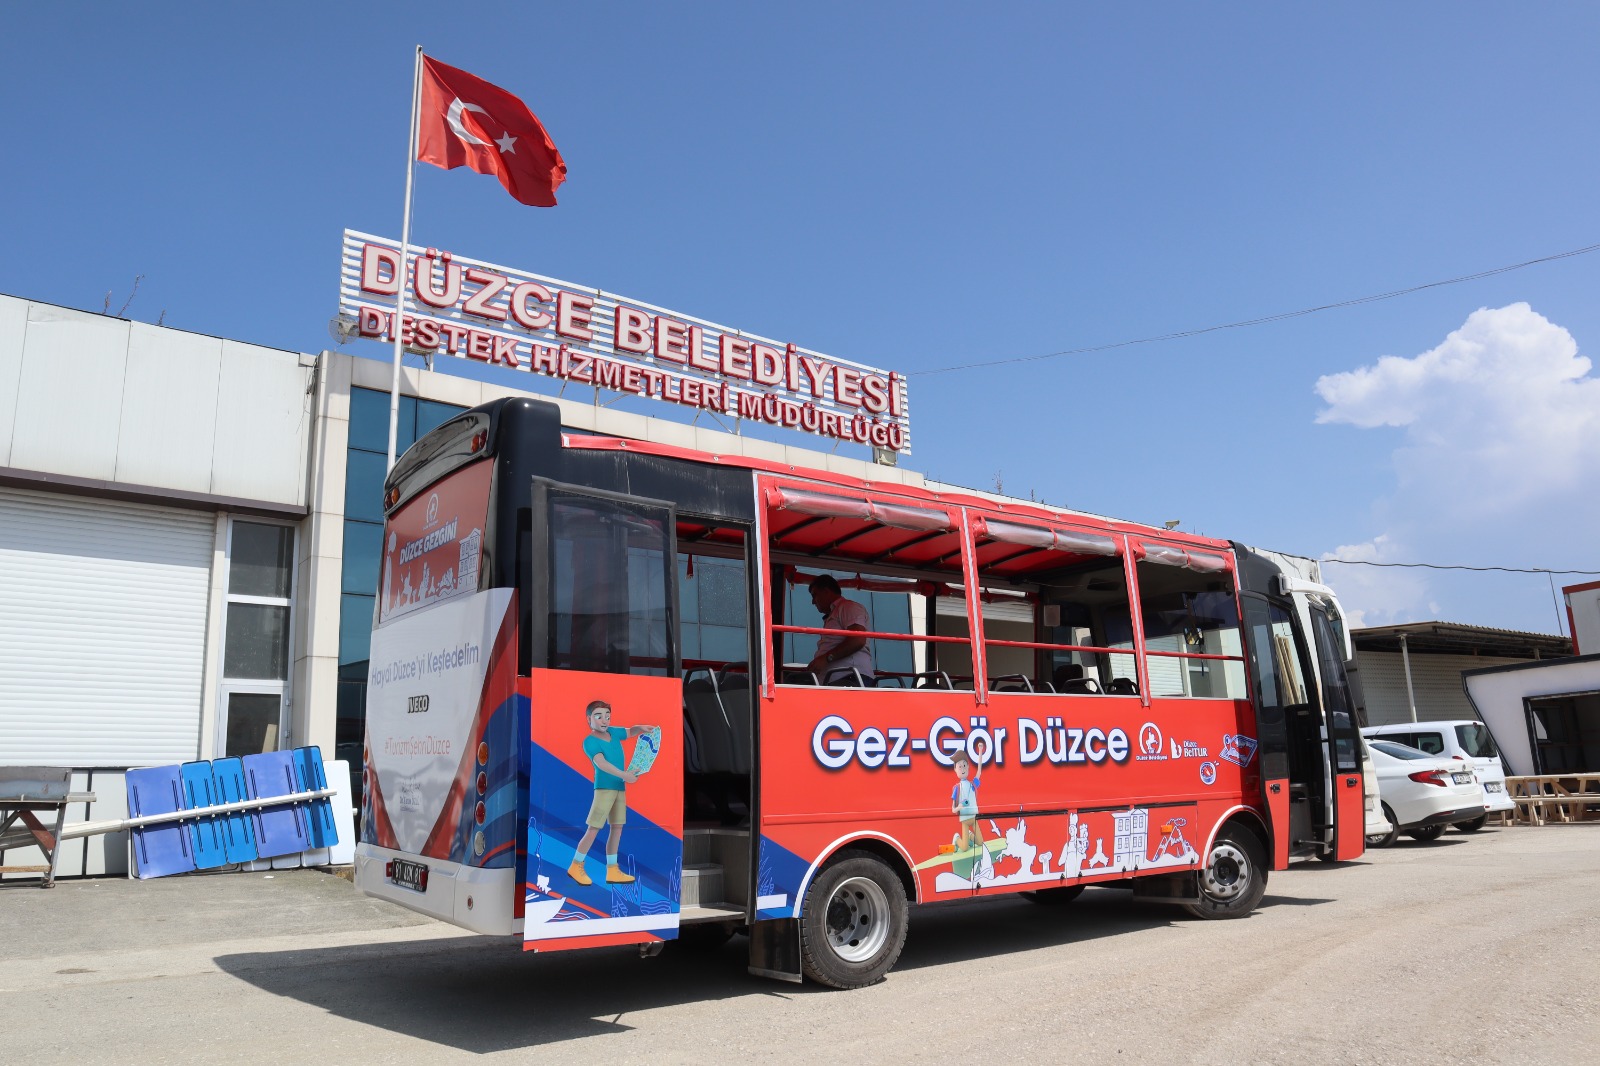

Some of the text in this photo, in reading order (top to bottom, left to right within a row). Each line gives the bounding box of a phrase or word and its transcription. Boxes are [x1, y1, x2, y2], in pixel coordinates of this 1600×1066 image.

[361, 243, 902, 417] DÜZCE BELEDİYESİ
[358, 306, 904, 450] DESTEK HİZMETLERİ MÜDÜRLÜĞÜ
[399, 516, 459, 565] DÜZCE GEZGİNİ
[427, 642, 479, 676] Keşfedelim
[407, 695, 429, 714] IVECO
[811, 714, 1129, 768] Gez-Gör Düzce
